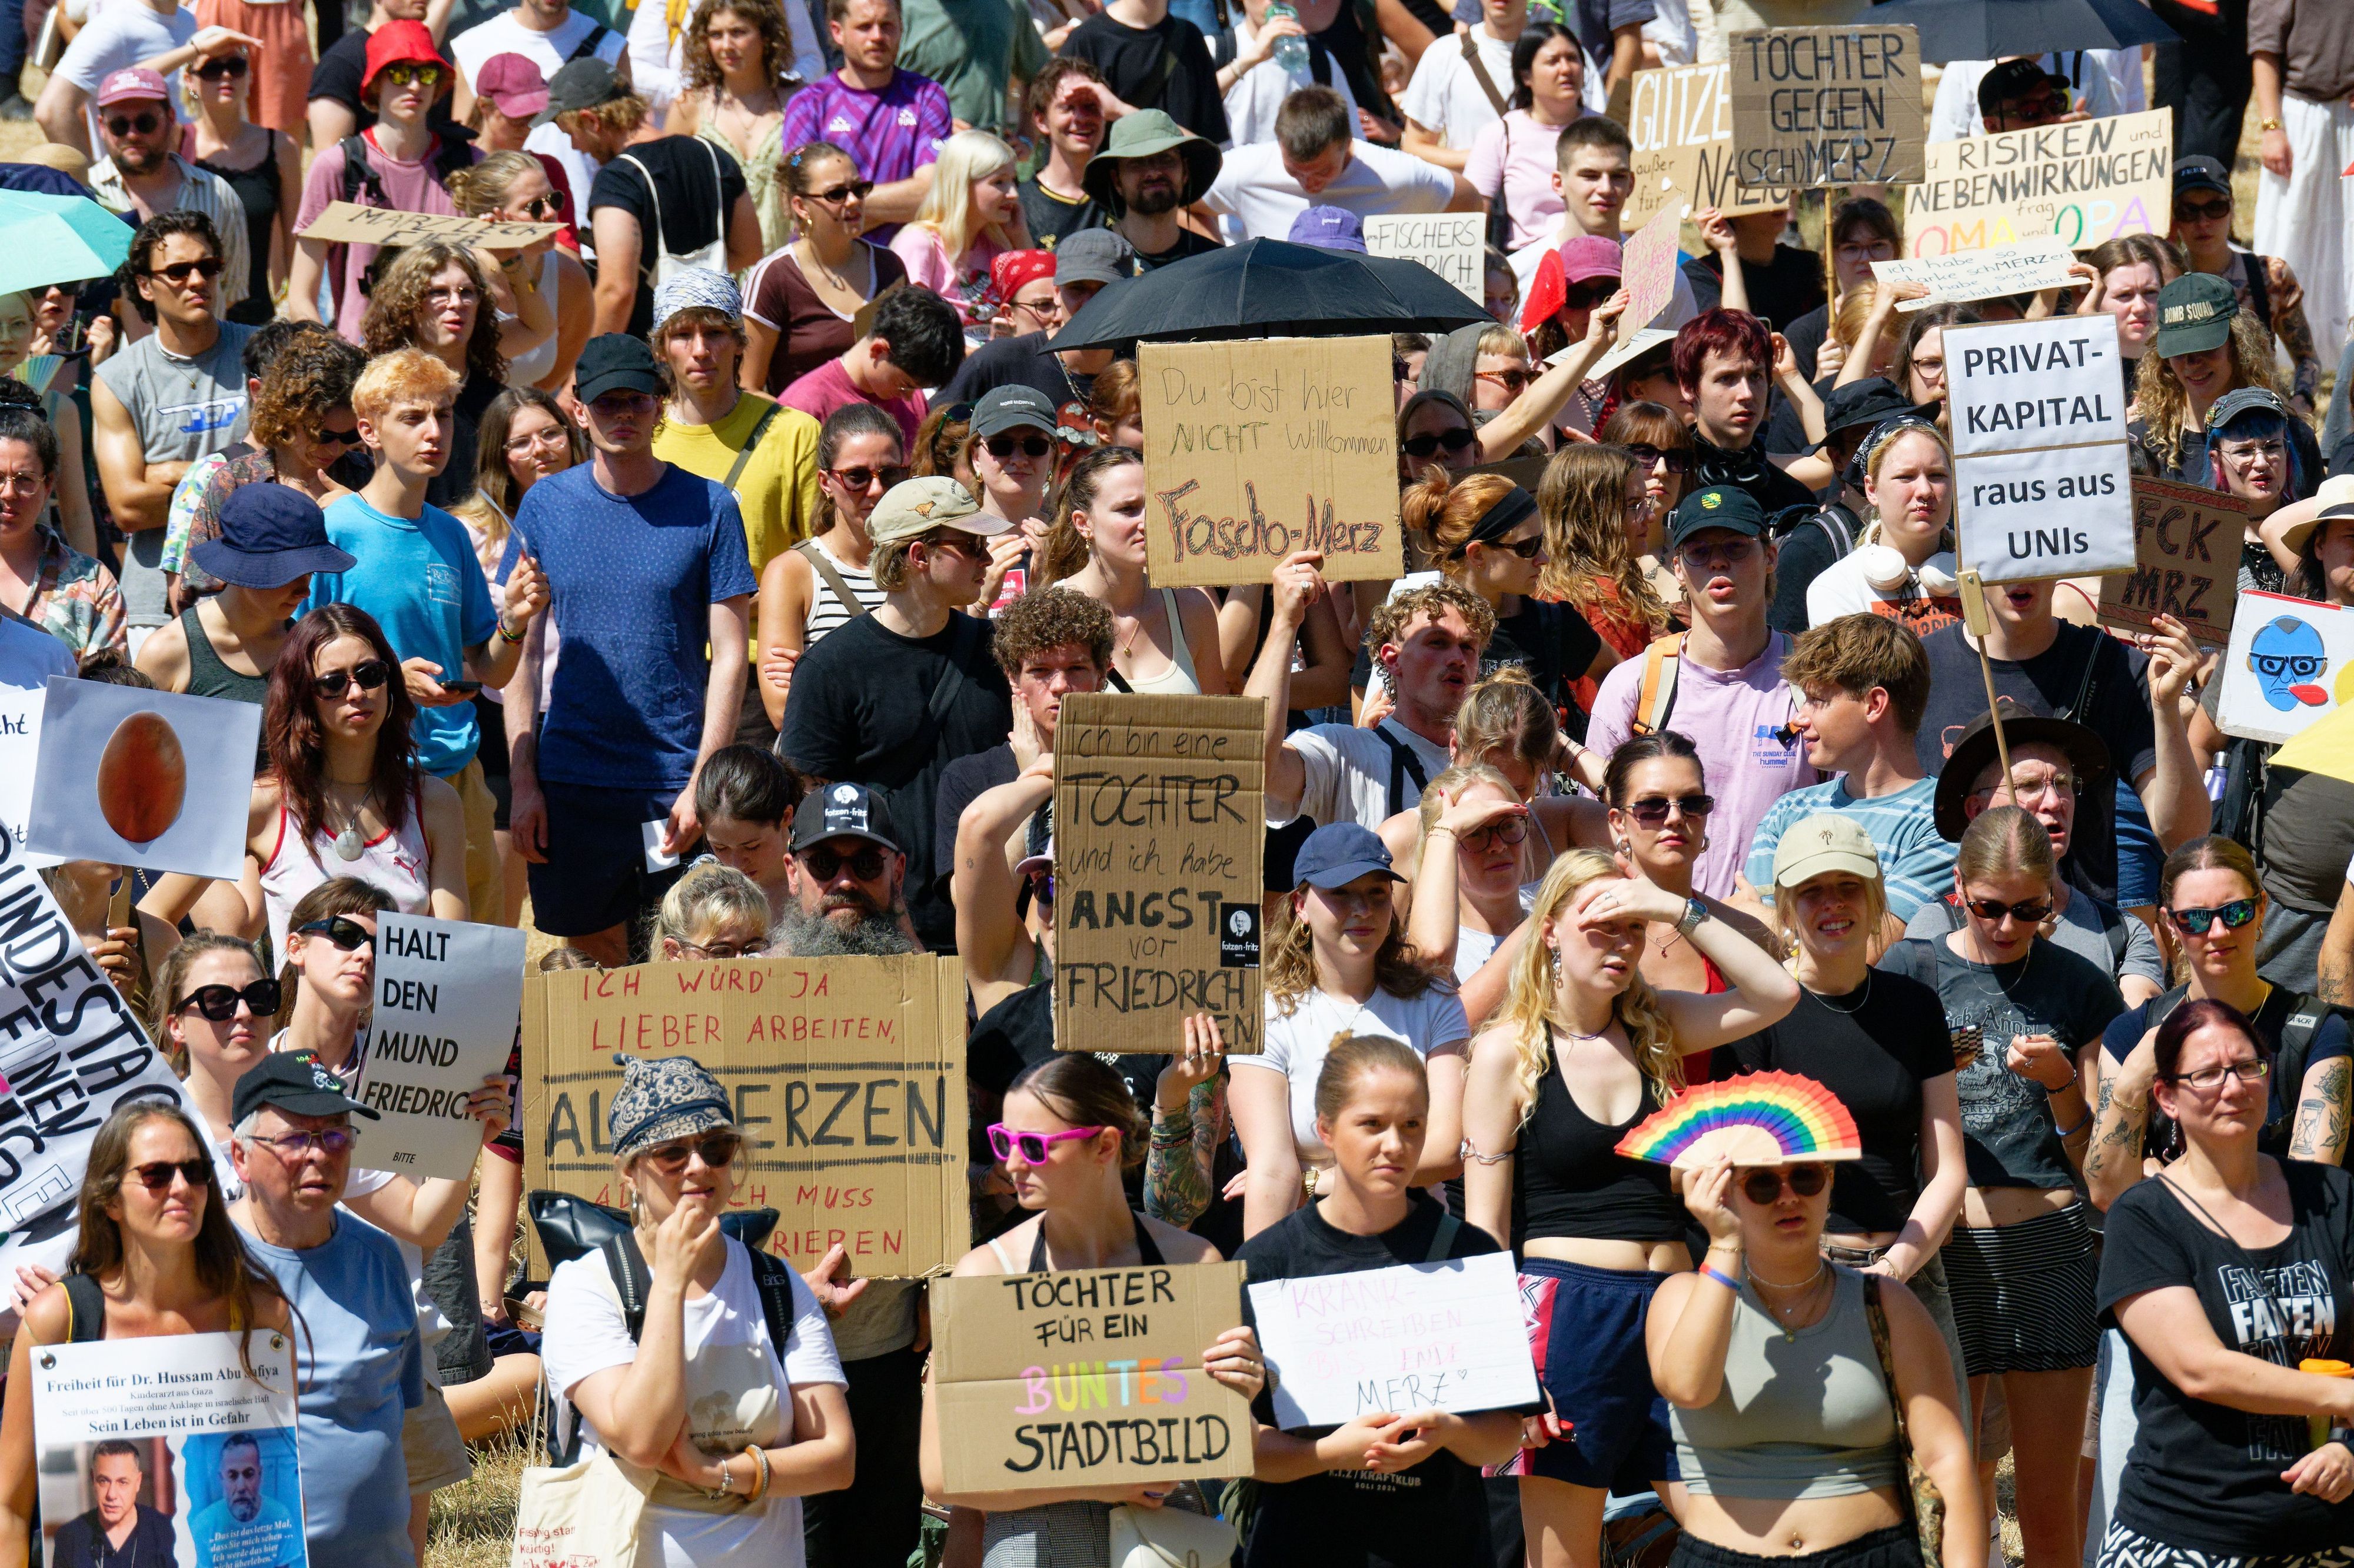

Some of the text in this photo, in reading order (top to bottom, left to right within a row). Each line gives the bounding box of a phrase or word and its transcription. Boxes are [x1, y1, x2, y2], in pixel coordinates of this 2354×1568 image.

[1744, 34, 1906, 81] TÖCHTER
[1770, 88, 1884, 132] GEGEN
[1738, 137, 1896, 185] (SCH)MERZ
[1959, 119, 2117, 171] RISIKEN
[2130, 119, 2163, 142] und
[1637, 154, 1675, 180] außer
[1909, 146, 2167, 215] NEBENWIRKUNGEN
[1914, 196, 2153, 259] OMA und OPA
[2017, 200, 2054, 221] frag
[1378, 220, 1476, 249] FISCHERS
[1926, 256, 1974, 269] habe
[1996, 251, 2016, 259] so
[1967, 251, 2072, 276] schMERZen
[1939, 269, 2040, 291] habe sogar
[2019, 275, 2063, 288] dabei
[2165, 300, 2215, 324] BOMB SQUAD
[1964, 338, 2103, 378] PRIVAT-
[1162, 367, 1358, 412] Du bist hier
[1967, 394, 2112, 434] KAPITAL
[1170, 420, 1389, 456] NICHT Willkommen
[1973, 472, 2115, 507] raus aus
[1155, 478, 1384, 563] Fascho-Merz
[2135, 498, 2220, 563] FCK
[2008, 527, 2089, 559] UNIs
[2122, 563, 2214, 621] MRZ
[1072, 711, 1228, 761] Ich bin eine
[1062, 771, 1246, 830] TOCHTER
[1070, 838, 1237, 878] und ich habe
[1069, 887, 1223, 935] ANGST
[385, 925, 451, 962] HALT
[1129, 937, 1177, 960] vor
[383, 978, 438, 1014] DEN
[584, 964, 829, 1000] ICH WÜRD' JA
[1060, 961, 1246, 1013] FRIEDRICH
[375, 1030, 458, 1067] MUND
[592, 1013, 896, 1051] LIEBER ARBEITEN,
[363, 1081, 480, 1121] FRIEDRIC
[393, 1151, 416, 1164] BITTE
[797, 1186, 874, 1210] MUSS
[1003, 1269, 1175, 1310] TÖCHTER
[1292, 1278, 1416, 1318] KRANK-
[1034, 1313, 1148, 1347] FÜR EIN
[1317, 1308, 1462, 1346] SCHREIBEN
[47, 1378, 101, 1393] Freiheit
[106, 1375, 127, 1387] für
[132, 1373, 152, 1386] Dr.
[158, 1369, 214, 1384] Hussam
[216, 1366, 242, 1380] Abu
[1308, 1342, 1461, 1380] BIS ENDE
[130, 1387, 214, 1400] Kinderarzt aus Gaza
[1014, 1356, 1188, 1415] BUNTES
[1356, 1373, 1449, 1416] MERZ
[62, 1394, 270, 1417] Seit über 500 Tagen ohne Anklage in israelischer Haft
[89, 1411, 251, 1433] Sein Leben ist in Gefahr
[1005, 1414, 1230, 1473] STADTBILD
[1360, 1470, 1422, 1486] KRAFTKLUB
[211, 1543, 228, 1552] dass
[242, 1536, 260, 1546] mich
[261, 1533, 282, 1542] sehen
[241, 1527, 253, 1536] das
[254, 1524, 273, 1533] letzte
[274, 1519, 292, 1530] Mal,
[212, 1544, 279, 1563] Ich werde das hier
